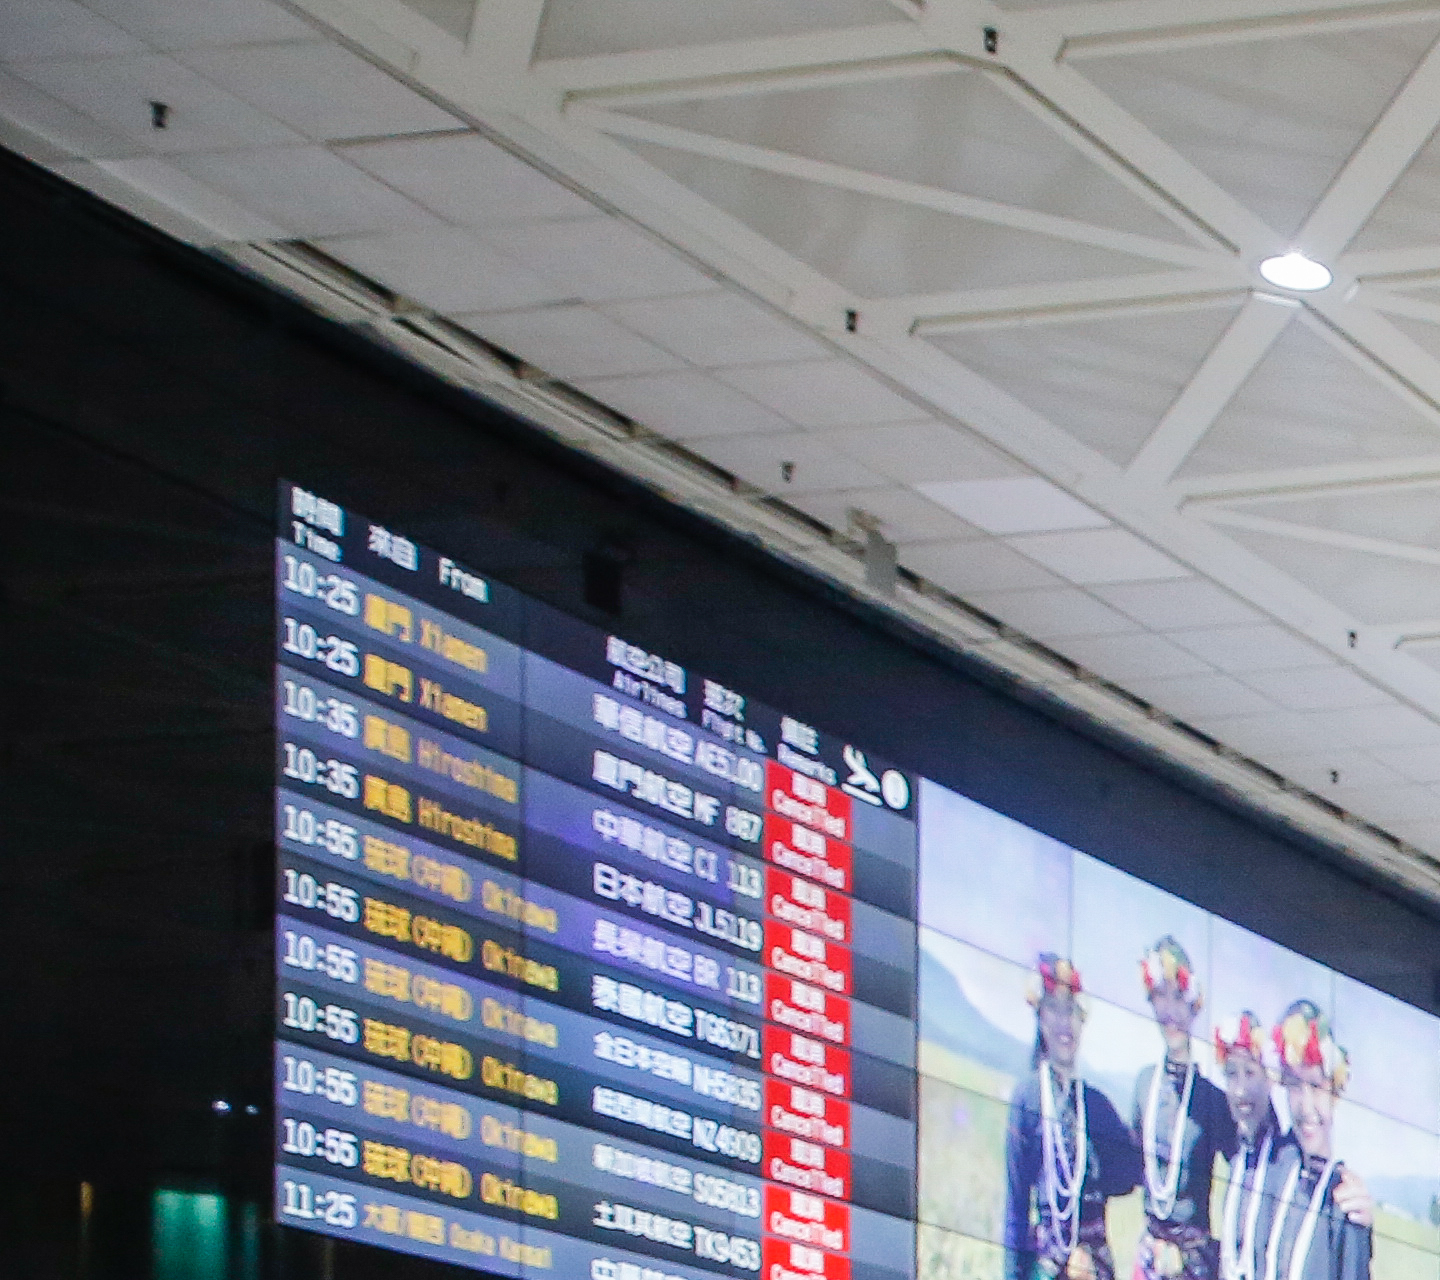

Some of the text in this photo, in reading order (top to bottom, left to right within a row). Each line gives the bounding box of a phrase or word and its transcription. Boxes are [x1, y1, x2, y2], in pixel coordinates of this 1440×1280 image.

[284, 556, 360, 615] 10:25
[284, 617, 360, 677] 10:25
[284, 680, 360, 738] 10:35
[284, 805, 360, 860] 10:55
[284, 742, 360, 798] 10:35
[592, 862, 694, 927] 日本航空
[284, 869, 360, 922] 10:55
[284, 931, 360, 983] 10:55
[284, 992, 360, 1043] 10:55
[284, 1056, 360, 1106] 10:55
[284, 1118, 360, 1167] 10:55
[284, 1181, 360, 1228] 11:25
